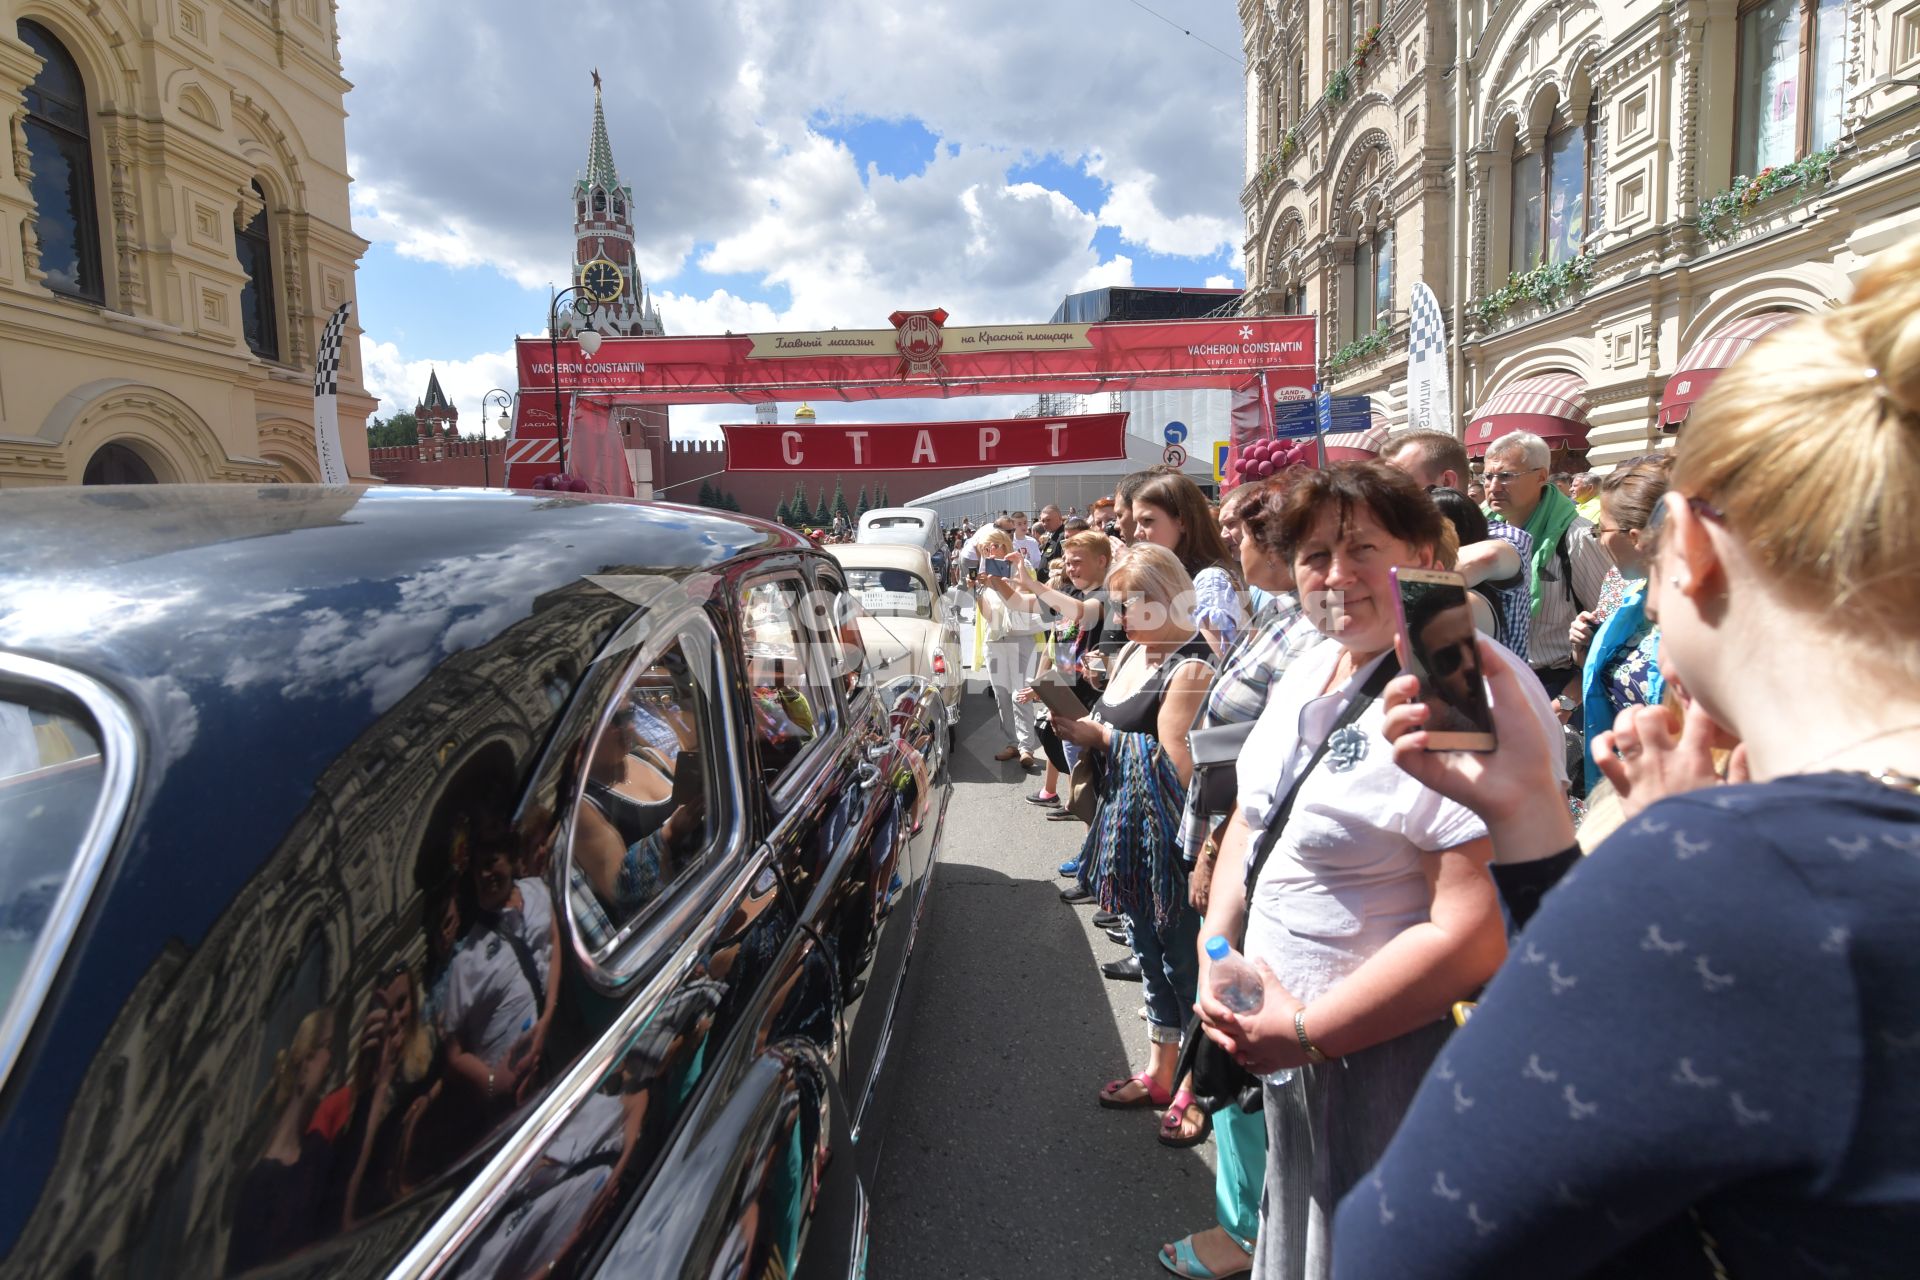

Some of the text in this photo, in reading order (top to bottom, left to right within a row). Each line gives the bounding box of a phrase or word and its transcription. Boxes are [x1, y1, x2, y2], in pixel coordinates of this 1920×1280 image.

[775, 337, 875, 349] Главный магазин
[961, 331, 1073, 344] на Красной площади
[1188, 341, 1303, 355] VACHERON CONSTANTIN
[586, 363, 645, 373] CONSTANTIN
[781, 422, 1067, 465] СТАРТ
